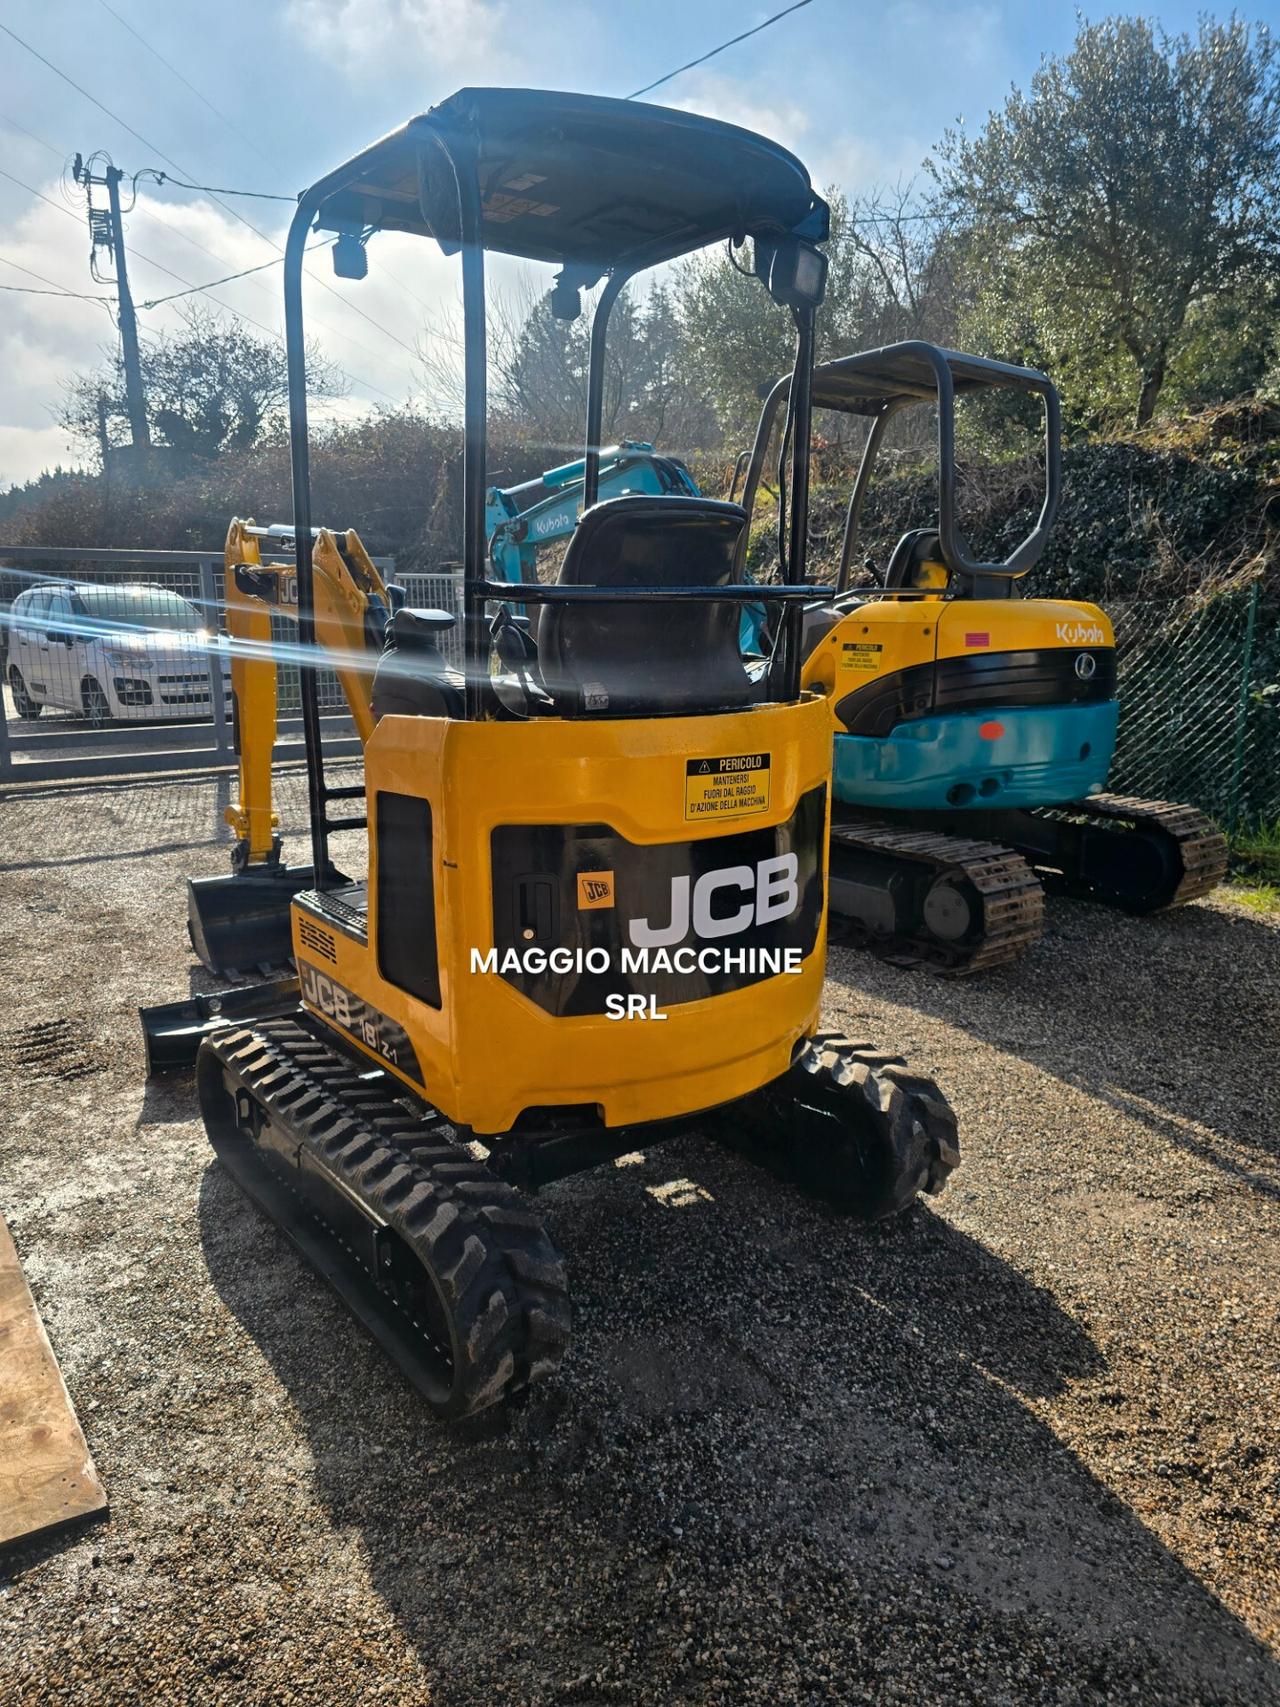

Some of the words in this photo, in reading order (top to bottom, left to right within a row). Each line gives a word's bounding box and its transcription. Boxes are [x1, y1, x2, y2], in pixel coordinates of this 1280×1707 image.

[536, 513, 569, 534] Kubota
[1056, 623, 1105, 643] Kubota
[719, 756, 762, 771] PERICOLO
[713, 774, 749, 786] MANTENERSI
[704, 789, 721, 799] FUORI
[723, 788, 734, 797] DAL
[736, 785, 756, 795] RAGGIO
[690, 801, 718, 812] D'AZIONE
[720, 799, 737, 809] DELLA
[739, 795, 765, 807] MACCHINA
[587, 882, 609, 901] JCB
[629, 852, 799, 948] JCB
[305, 969, 351, 1028] JCB
[360, 1018, 377, 1049] 18
